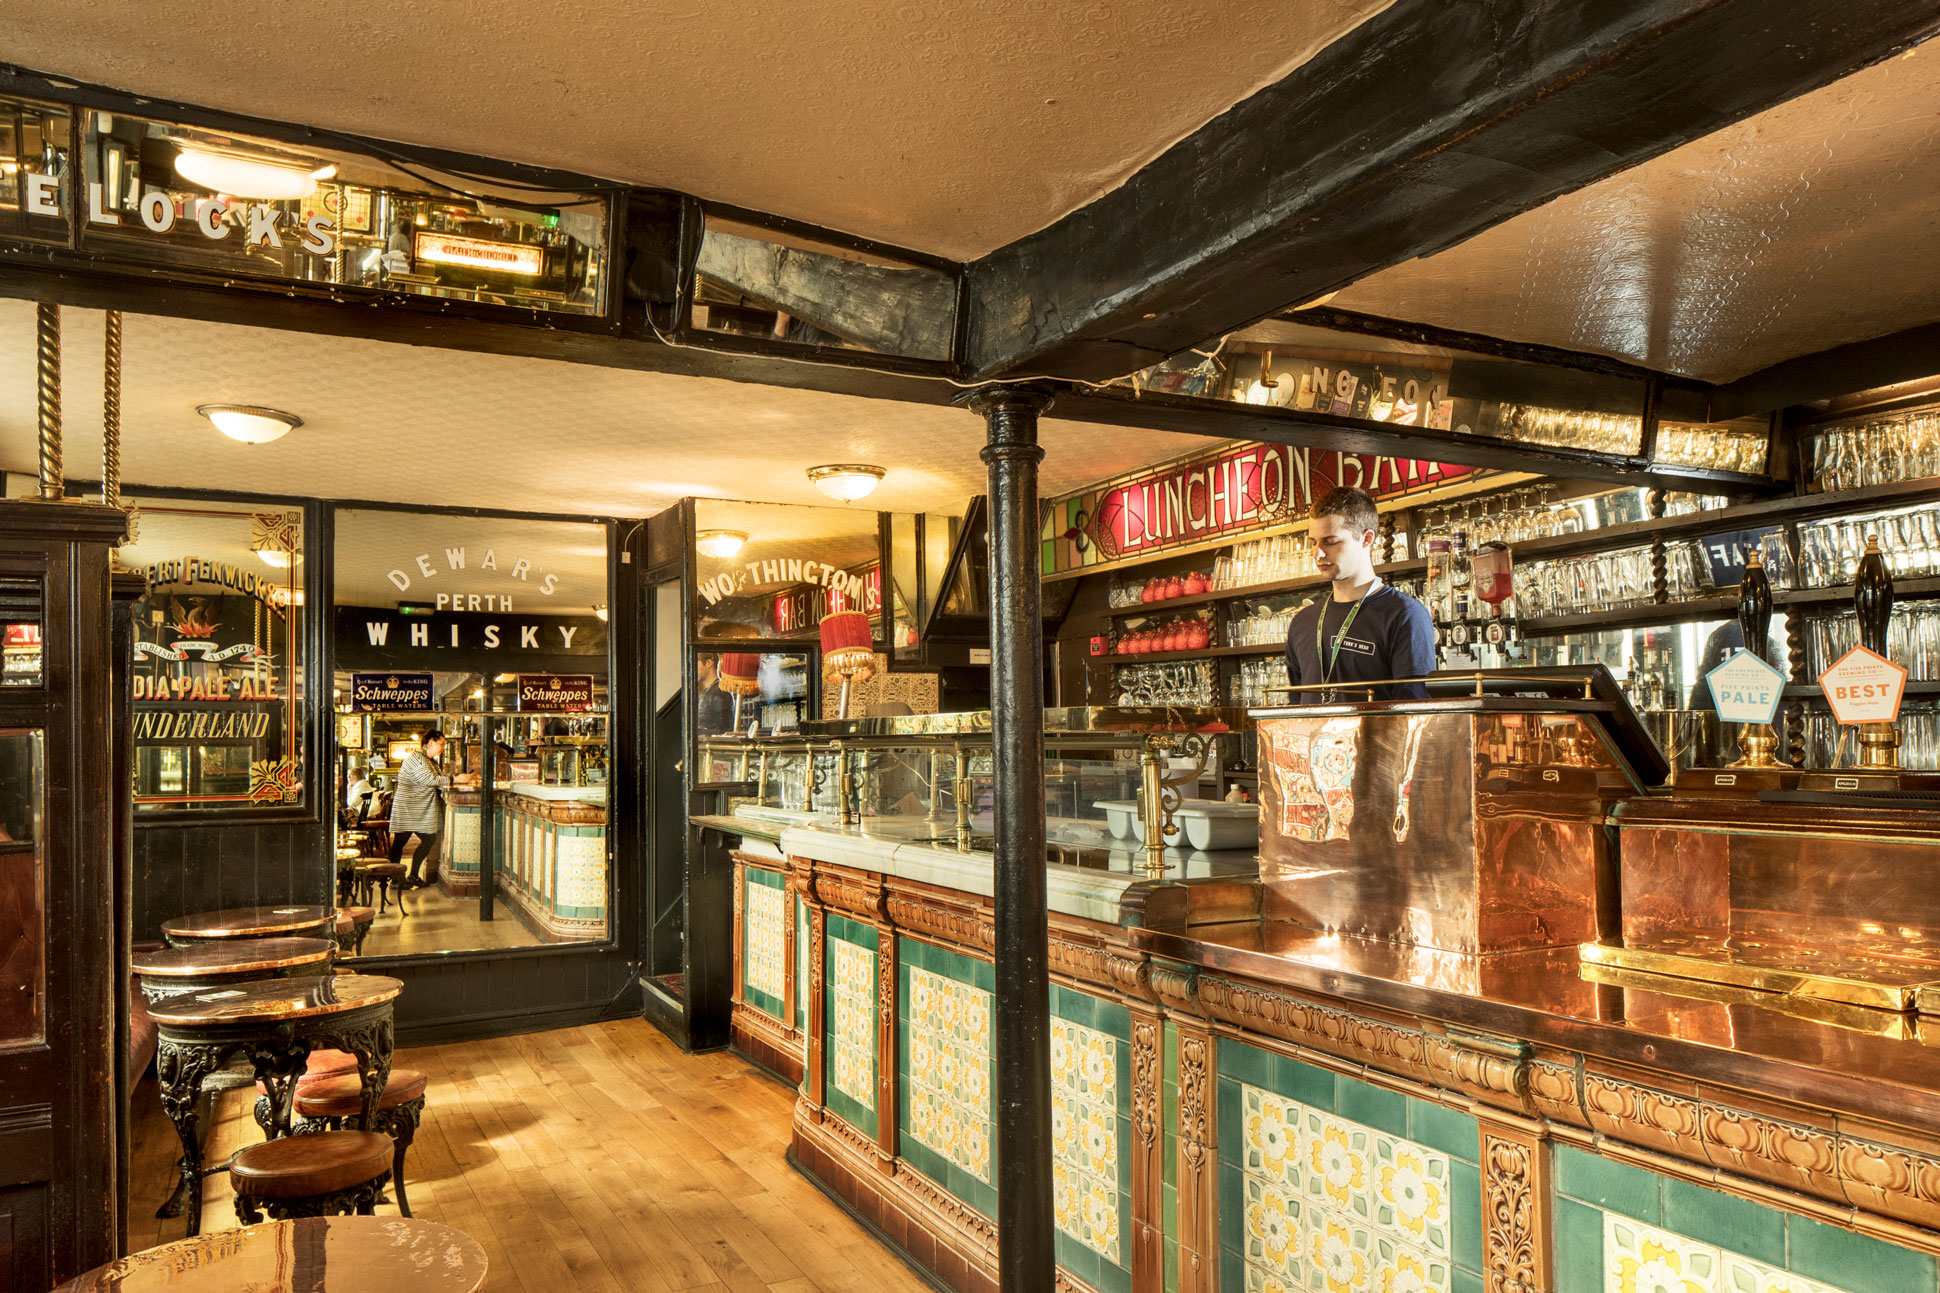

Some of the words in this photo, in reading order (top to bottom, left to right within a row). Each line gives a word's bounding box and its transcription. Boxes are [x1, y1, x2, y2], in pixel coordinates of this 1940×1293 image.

[1122, 444, 1313, 548] LUNCHEON
[183, 555, 266, 602] FENWICK
[386, 546, 560, 596] DEWAR'S
[436, 593, 514, 612] PERTH
[366, 621, 579, 649] WHISKY
[177, 675, 231, 700] PALE
[239, 676, 280, 700] ALE
[355, 685, 429, 703] Schweppes
[521, 686, 589, 703] Schweppes
[1720, 691, 1770, 705] PALE
[1835, 683, 1891, 700] BEST
